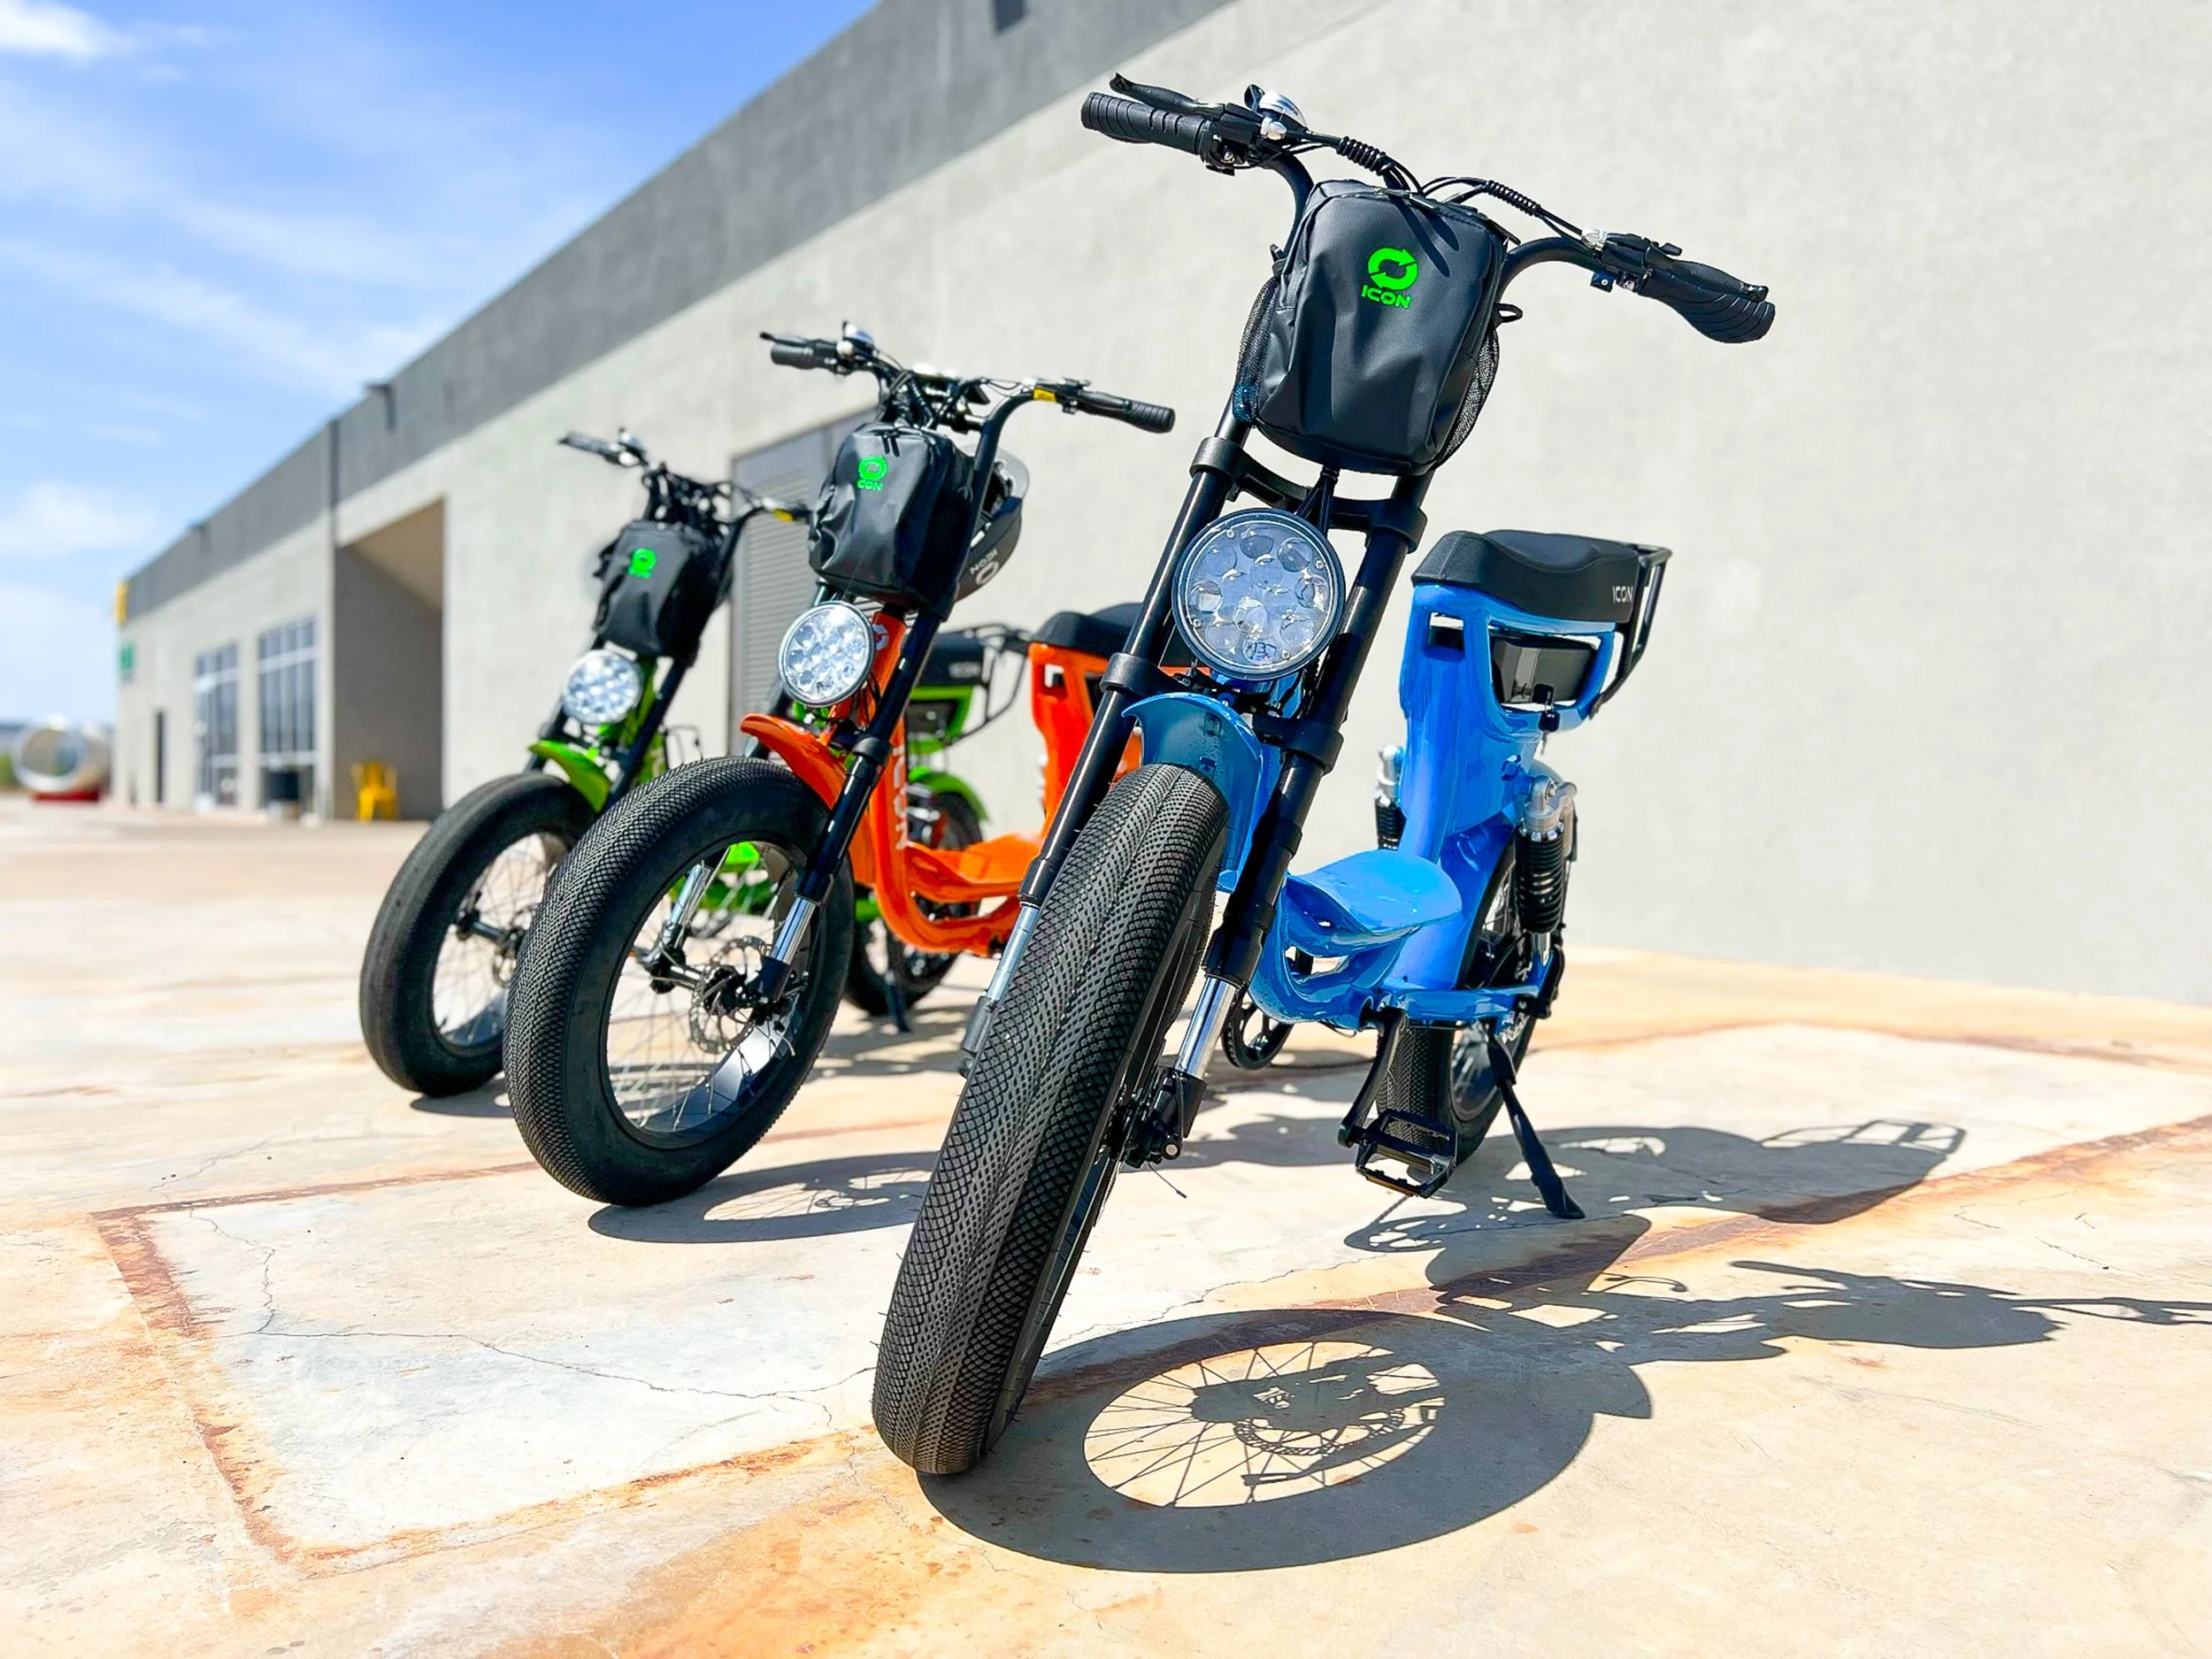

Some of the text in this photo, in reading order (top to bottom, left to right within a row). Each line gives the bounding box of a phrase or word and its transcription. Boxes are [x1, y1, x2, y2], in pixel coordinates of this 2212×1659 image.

[1361, 284, 1412, 309] ICON
[970, 548, 998, 575] ICON
[1612, 585, 1634, 603] ICON
